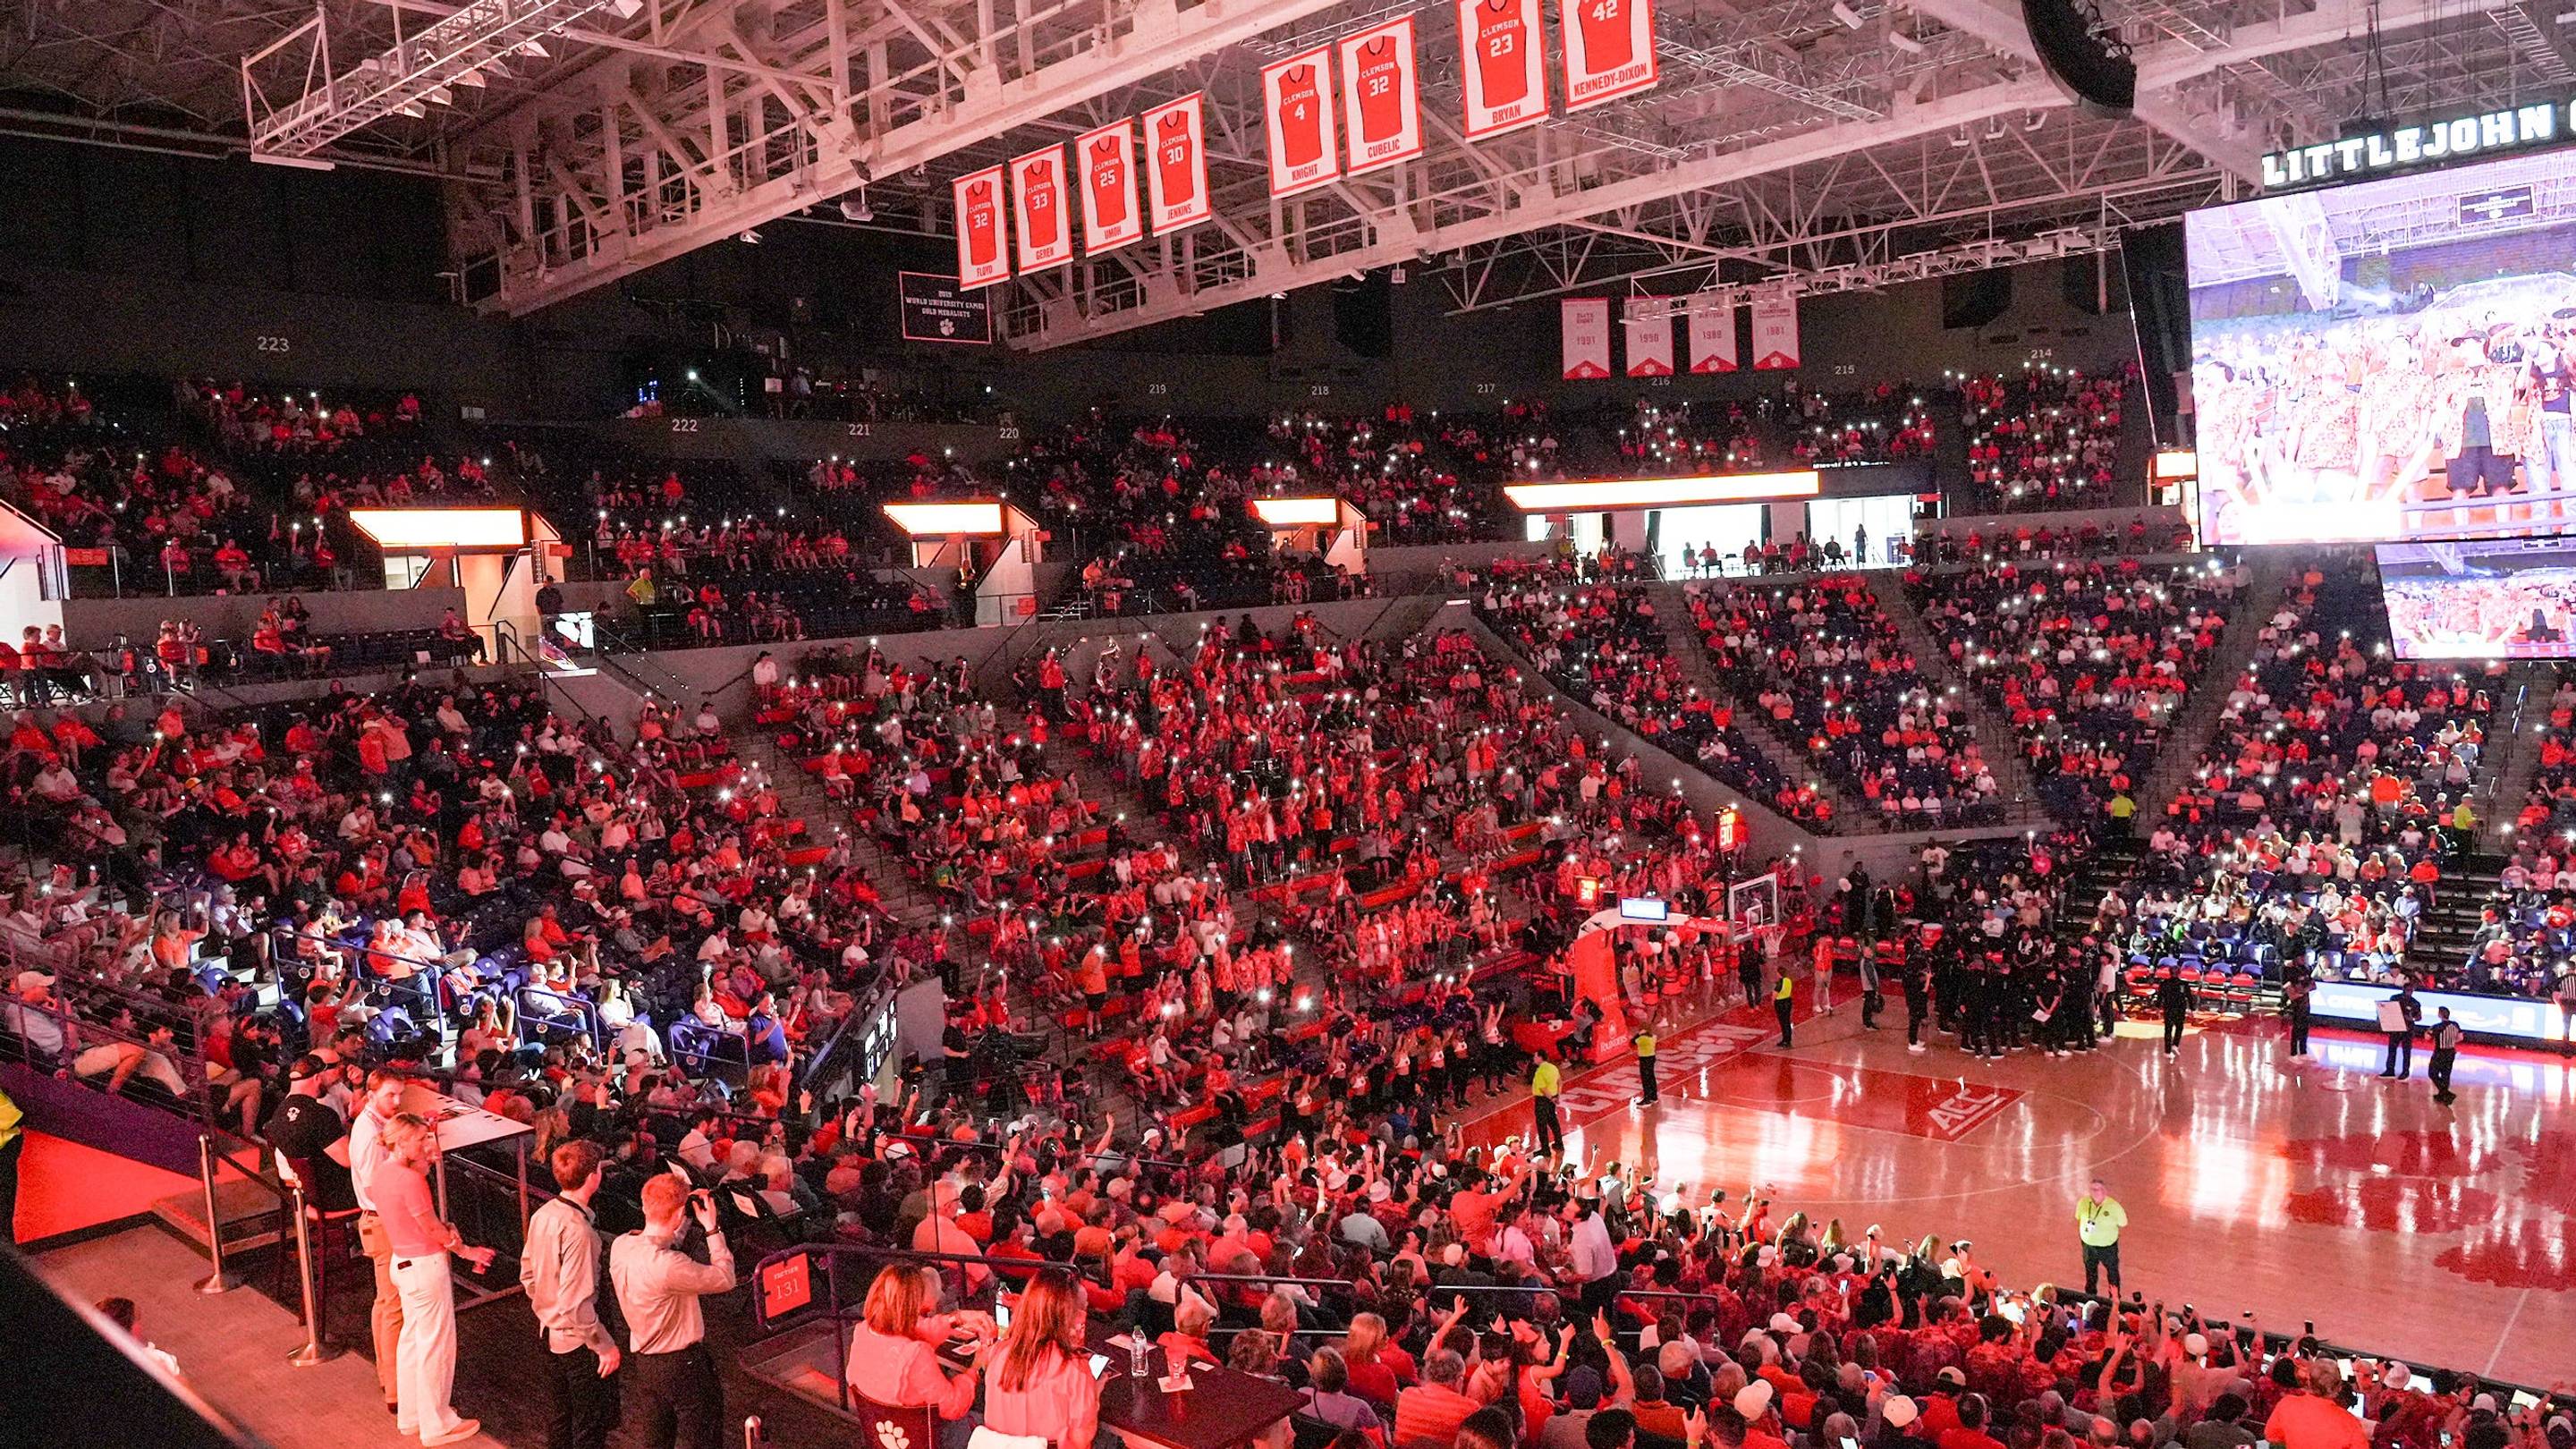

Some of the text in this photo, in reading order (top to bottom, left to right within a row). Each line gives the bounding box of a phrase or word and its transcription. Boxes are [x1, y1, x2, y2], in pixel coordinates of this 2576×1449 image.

[1592, 0, 1618, 21] 42
[1481, 19, 1520, 38] CLEMSON
[1489, 33, 1513, 57] 23
[1361, 62, 1394, 79] CLEMSON
[1368, 75, 1389, 97] 32
[1573, 63, 1647, 97] KENNEDY-DIXON
[1283, 89, 1315, 106] CLEMSON
[1294, 103, 1306, 121] 4
[1492, 105, 1521, 123] BRYAN
[1161, 133, 1188, 148] CLEMSON
[1368, 139, 1401, 158] CUBELIC
[2262, 103, 2555, 187] LITTLEJOHN
[1166, 146, 1183, 165] 30
[1094, 157, 1119, 172] CLEMSON
[1292, 164, 1318, 182] KNIGHT
[1099, 170, 1115, 188] 25
[1032, 192, 1048, 210] 33
[974, 212, 987, 229] 32
[1167, 204, 1191, 221] JENKINS
[1104, 226, 1122, 240] UMOH
[976, 265, 993, 277] FLOYD
[905, 297, 928, 305] WORLD
[257, 335, 289, 352] 223
[2030, 349, 2052, 359] 214
[1835, 365, 1854, 376] 215
[1148, 384, 1166, 394] 219
[1477, 384, 1495, 394] 217
[1651, 377, 1670, 386] 216
[1311, 386, 1329, 396] 218
[672, 419, 698, 433] 222
[849, 422, 870, 436] 221
[999, 427, 1020, 440] 220
[1928, 1088, 1999, 1131] ACC
[775, 1277, 801, 1301] 131
